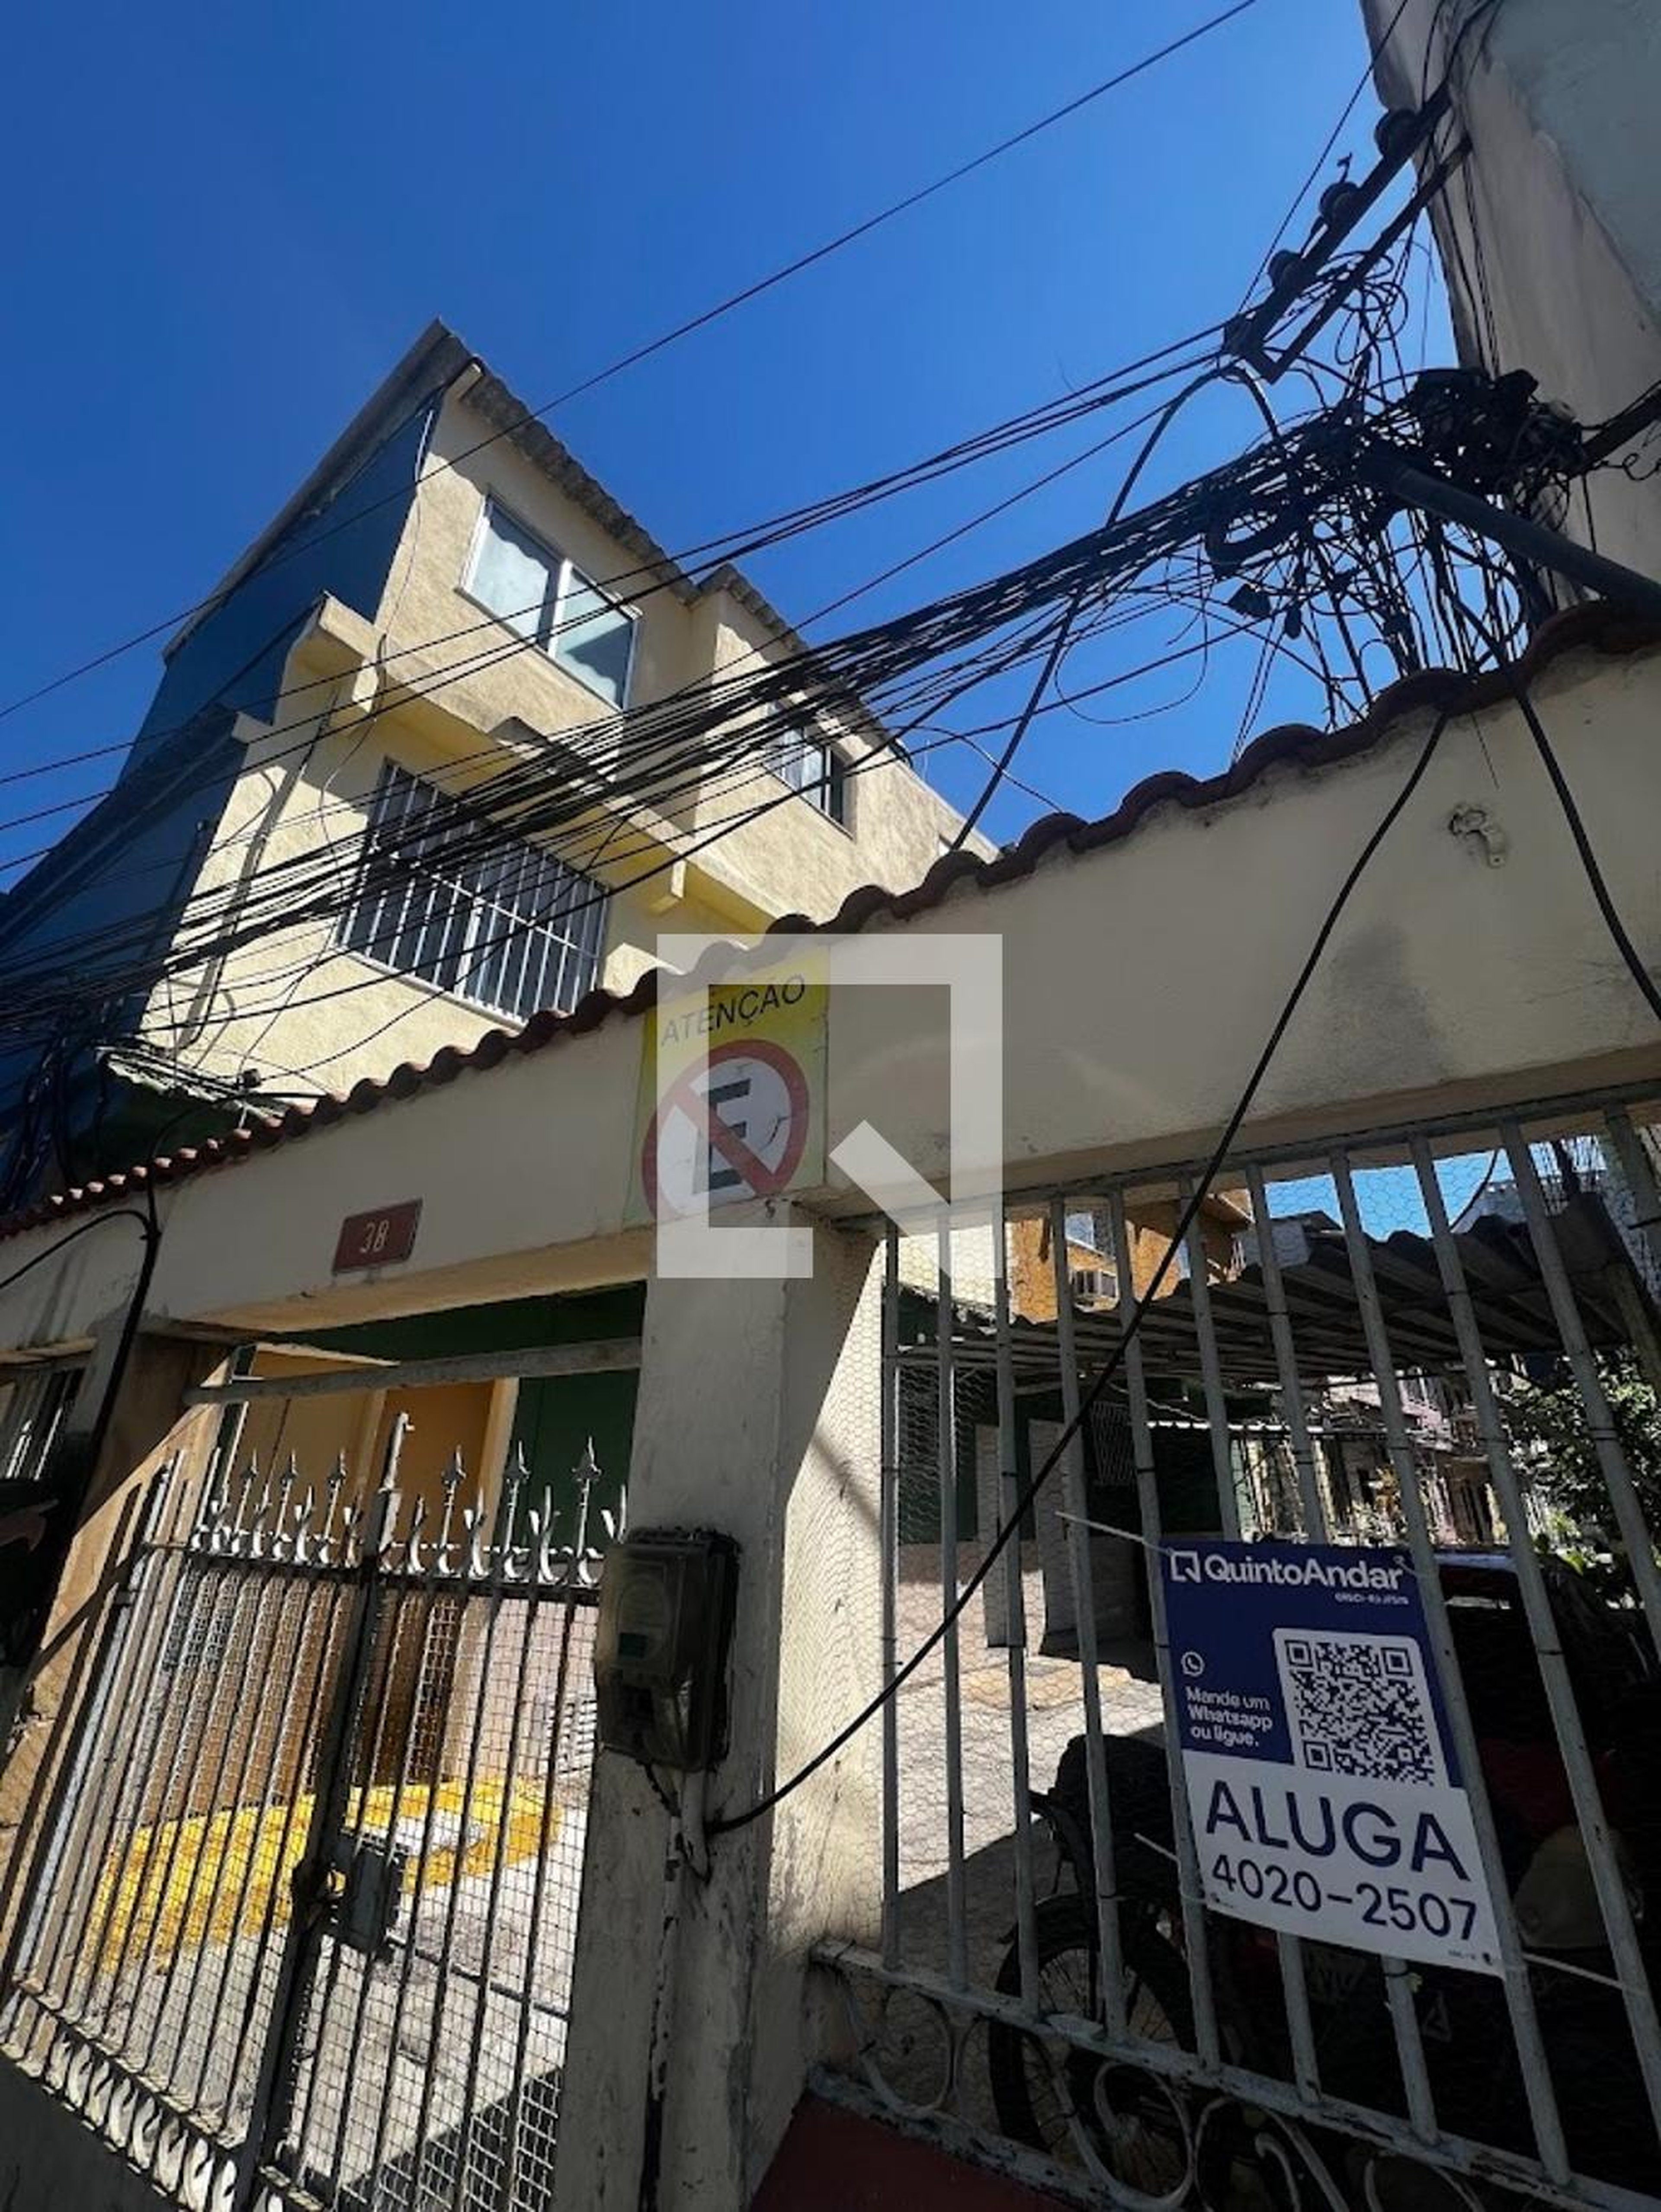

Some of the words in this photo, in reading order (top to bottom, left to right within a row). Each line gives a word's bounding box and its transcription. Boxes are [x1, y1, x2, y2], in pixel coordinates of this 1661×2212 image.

[360, 1219, 389, 1253] 38
[1204, 1554, 1403, 1590] QuintoAndar
[1186, 1686, 1241, 1707] Mande
[1242, 1697, 1271, 1711] um
[1188, 1704, 1273, 1732] Whatsapp
[1191, 1726, 1212, 1740] ou
[1213, 1725, 1260, 1747] ligue.
[1206, 1779, 1471, 1882] ALUGA
[1212, 1853, 1477, 1940] 4020-2507
